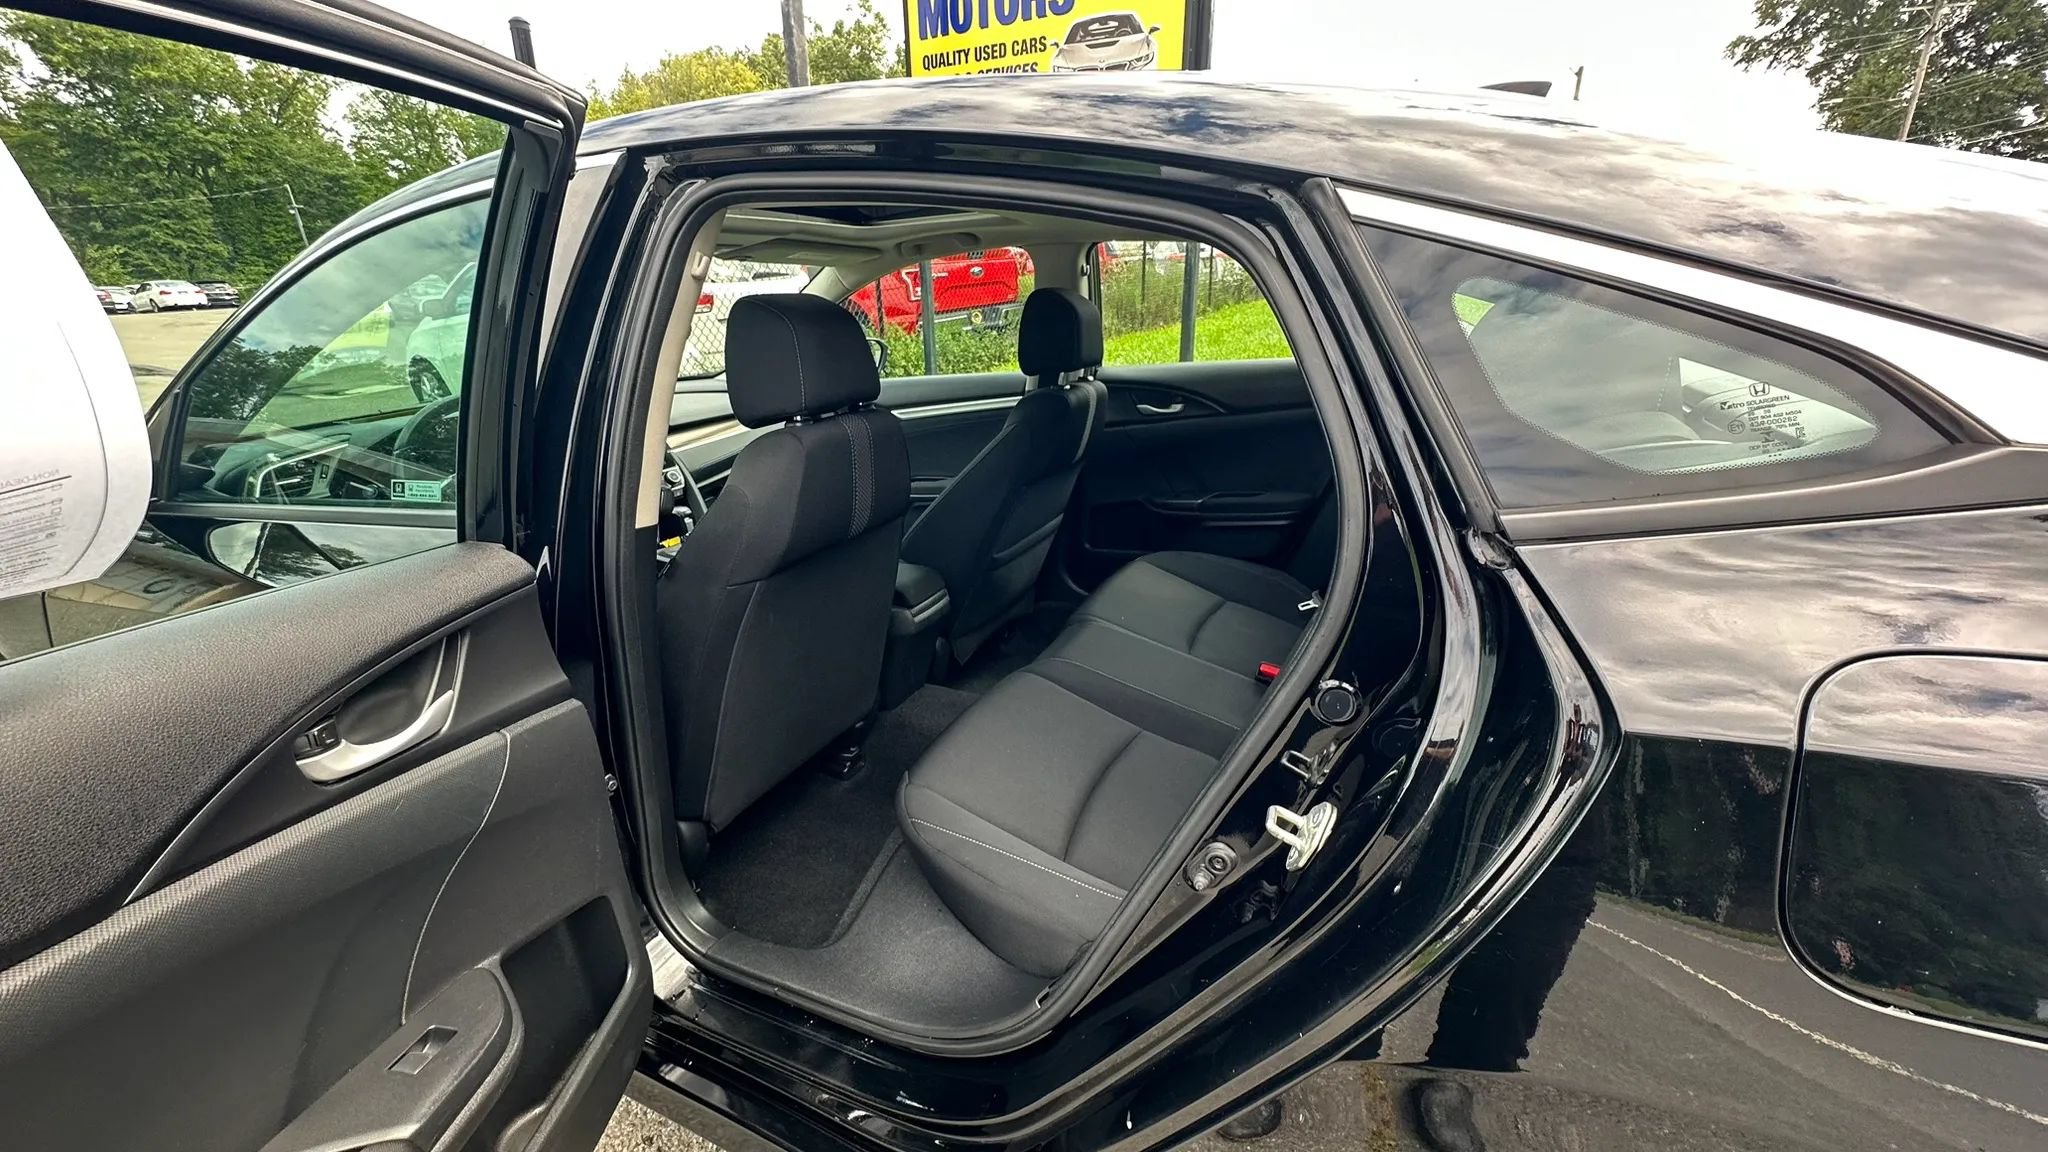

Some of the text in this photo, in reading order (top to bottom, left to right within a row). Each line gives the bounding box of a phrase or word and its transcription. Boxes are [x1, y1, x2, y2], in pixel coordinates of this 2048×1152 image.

[922, 36, 1047, 71] QUALITY USED CARS
[977, 62, 1039, 75] VICES
[1746, 395, 1790, 406] SOLARGREEN
